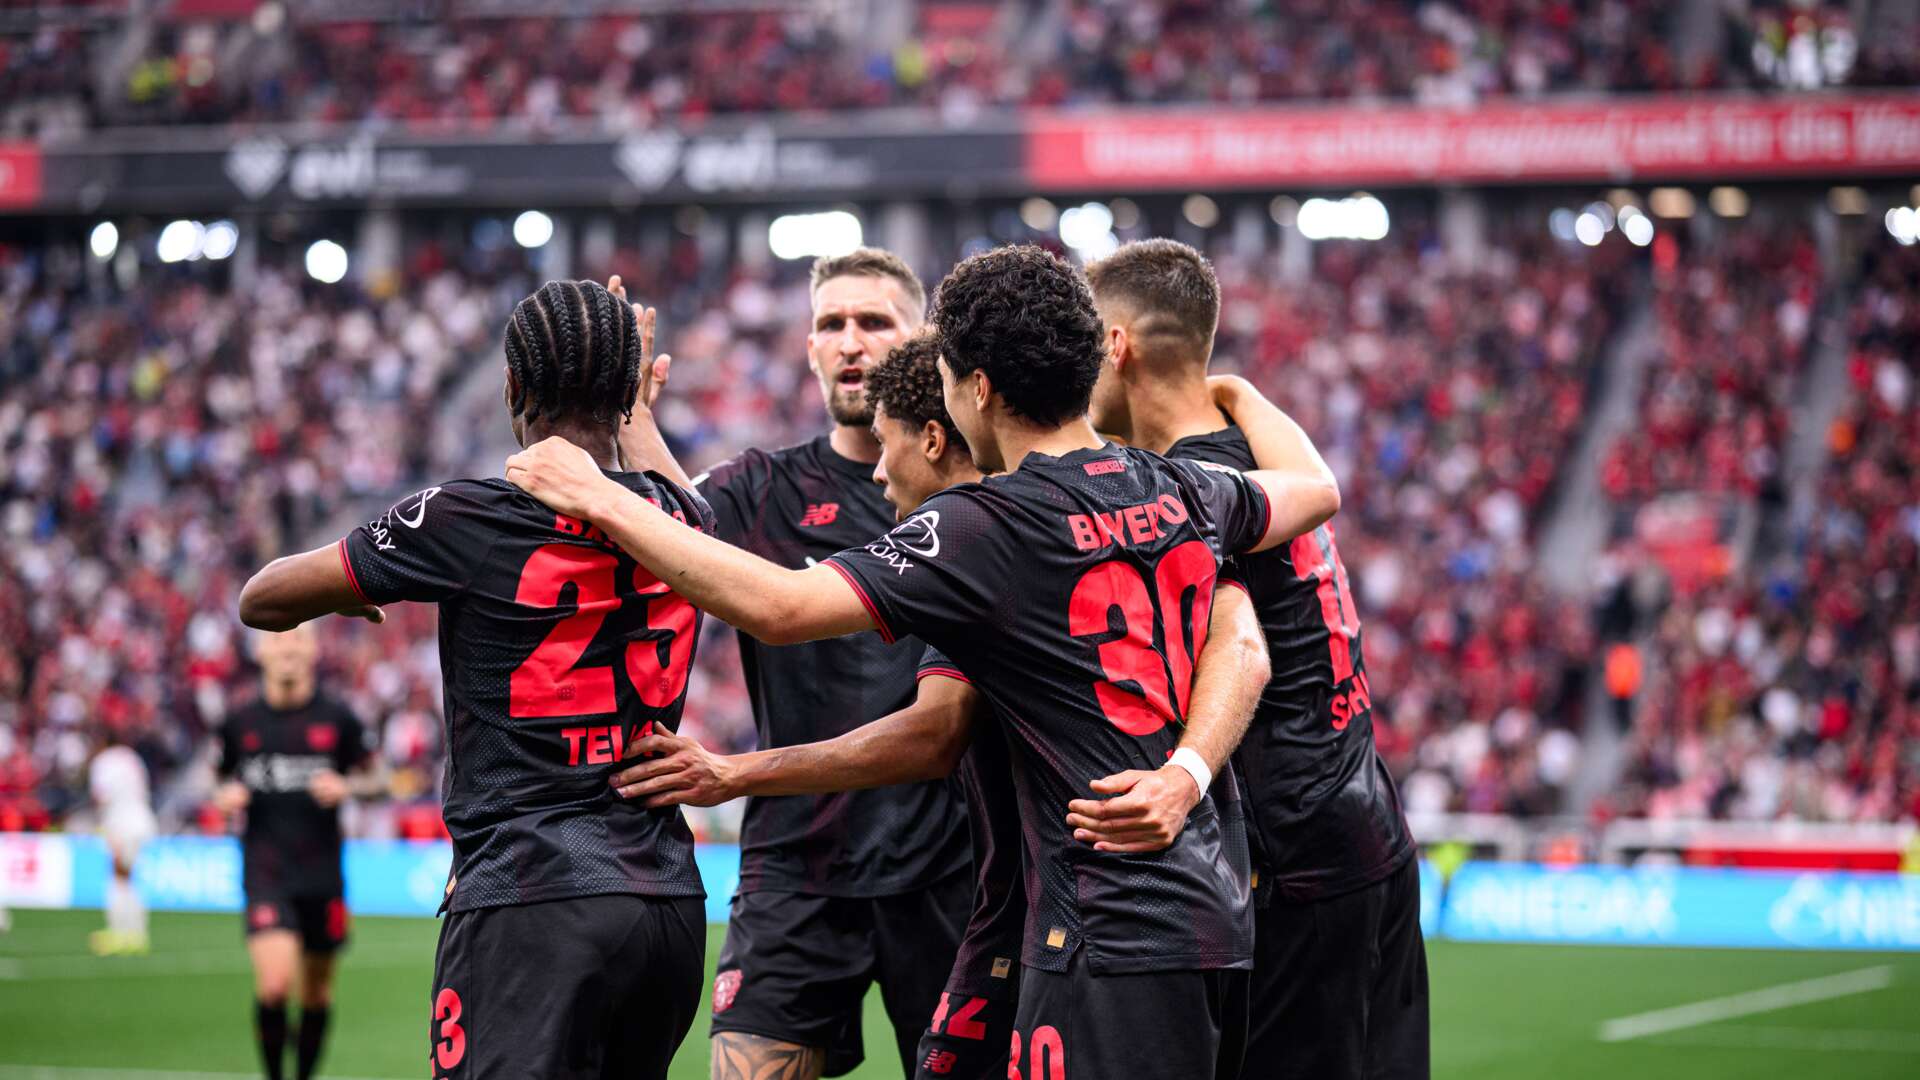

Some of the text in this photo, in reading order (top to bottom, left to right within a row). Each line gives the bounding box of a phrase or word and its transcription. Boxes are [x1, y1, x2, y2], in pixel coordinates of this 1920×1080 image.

[510, 543, 697, 718] 23
[1068, 540, 1217, 736] 30
[430, 988, 466, 1070] 3
